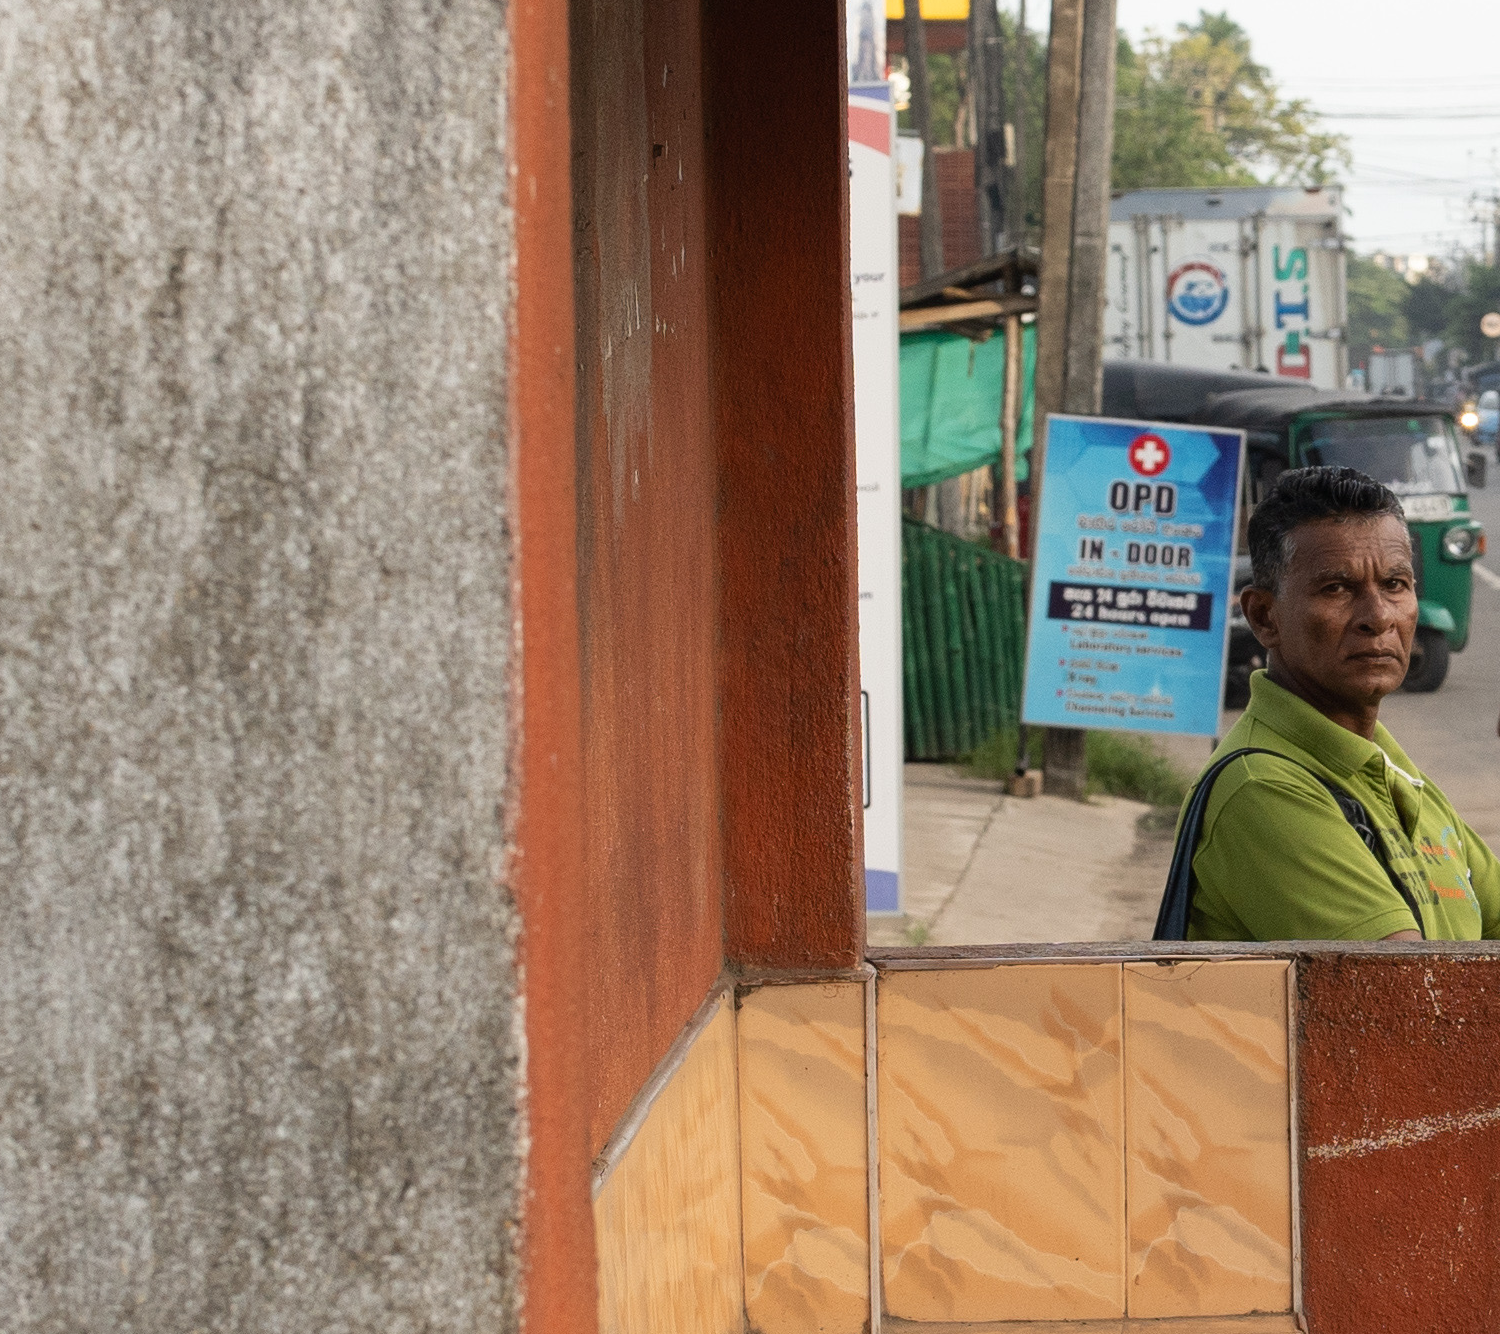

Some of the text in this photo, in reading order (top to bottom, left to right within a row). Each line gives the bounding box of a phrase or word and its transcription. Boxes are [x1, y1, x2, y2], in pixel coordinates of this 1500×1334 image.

[1109, 481, 1176, 515] OPD
[1070, 602, 1191, 628] 24 hours open
